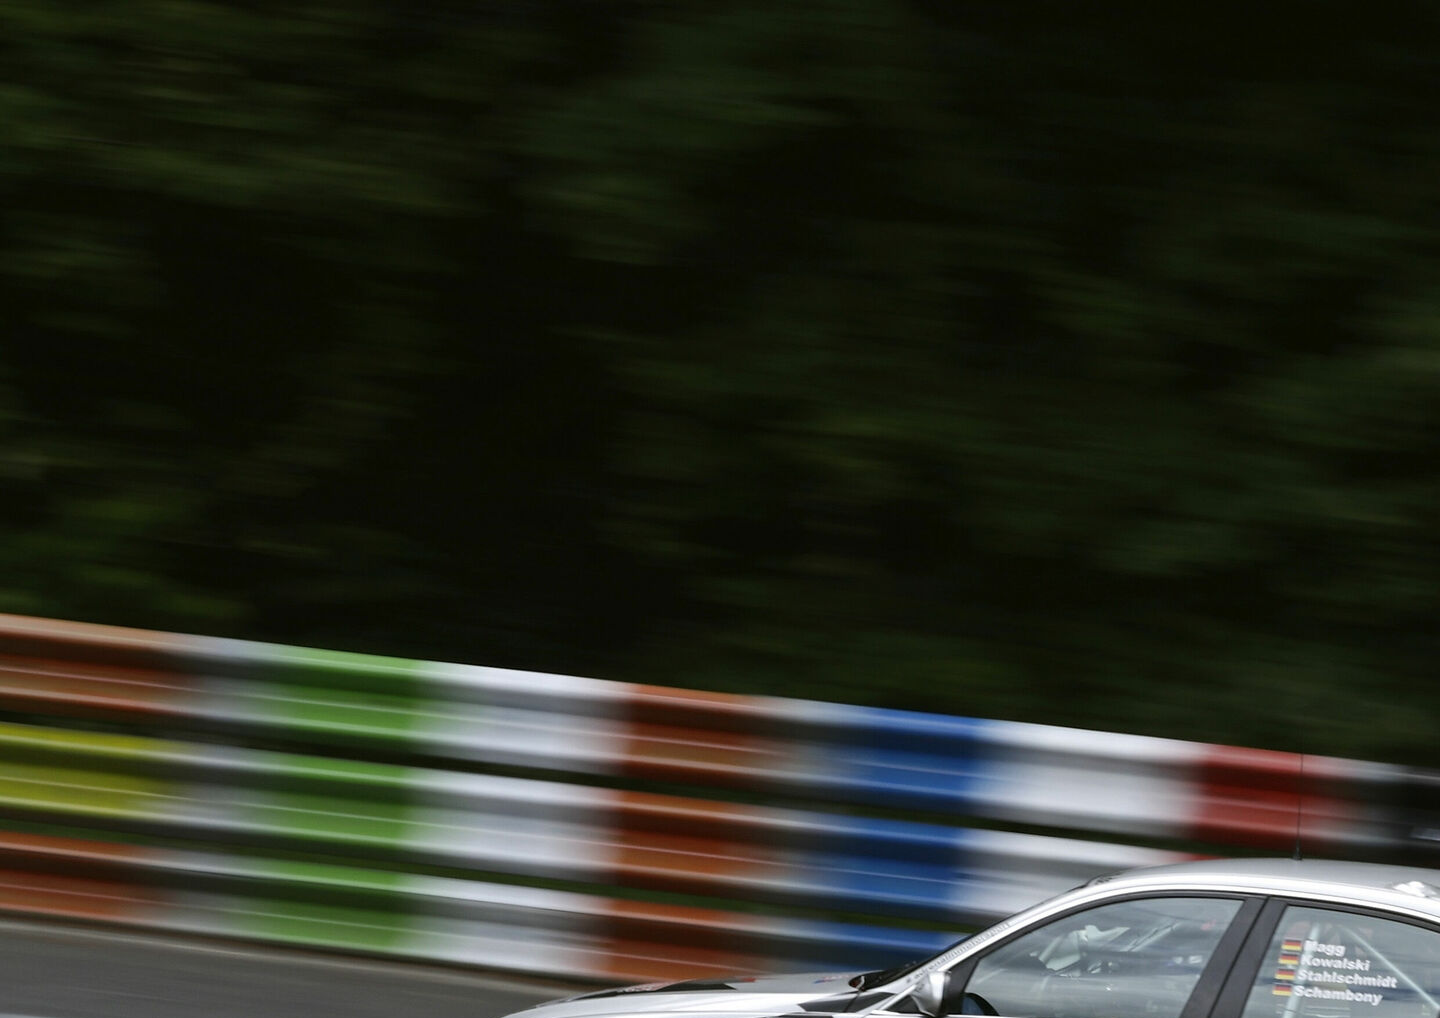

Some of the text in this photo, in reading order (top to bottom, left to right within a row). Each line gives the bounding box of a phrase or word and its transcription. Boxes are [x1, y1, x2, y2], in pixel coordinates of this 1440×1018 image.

[1300, 954, 1371, 972] Kowalski
[1297, 968, 1398, 989] Stahlschmidt
[1293, 985, 1383, 1006] Schambony
